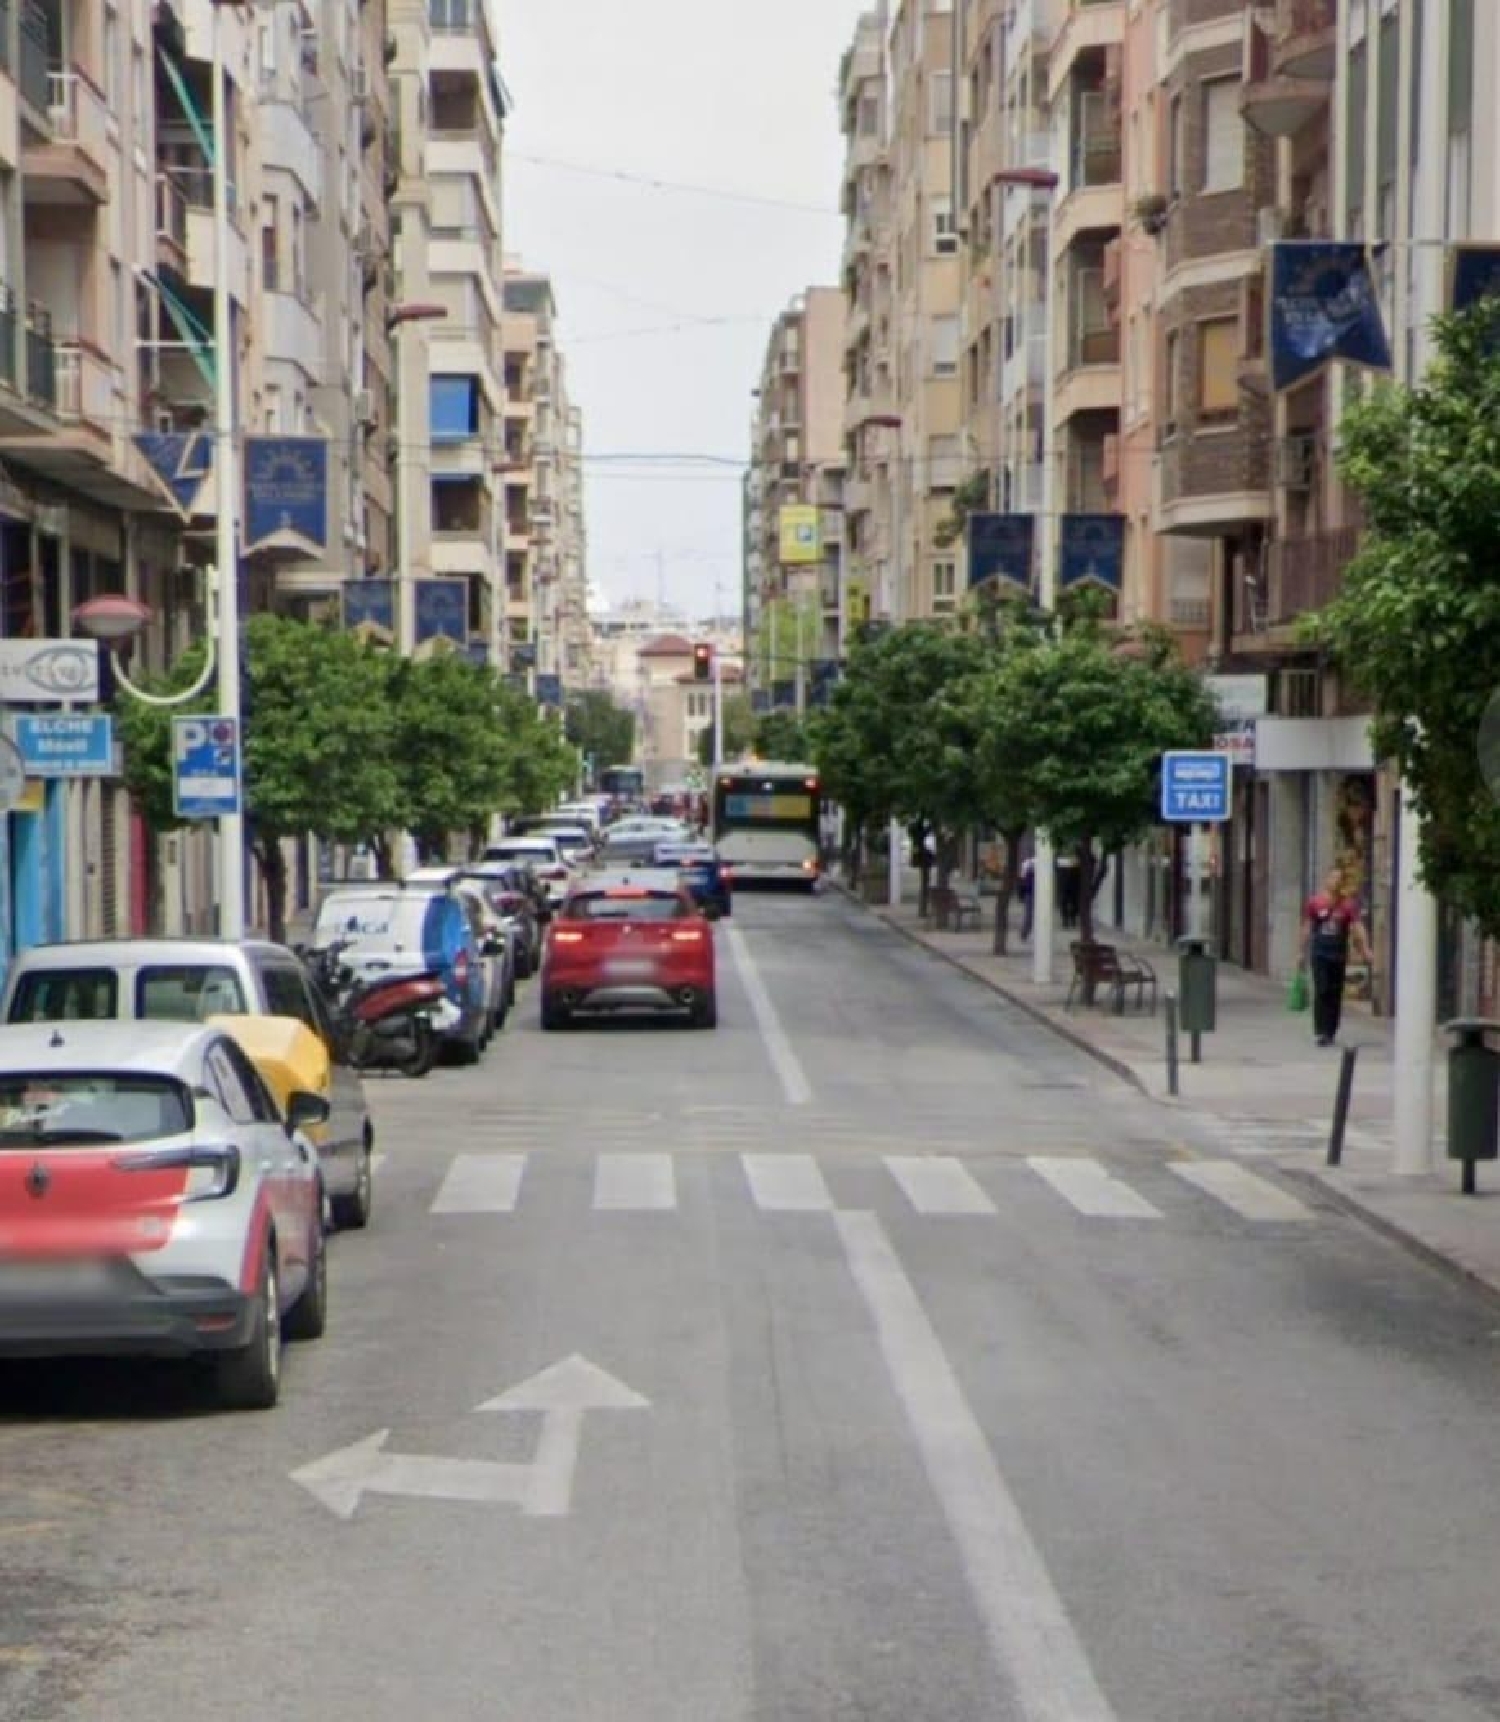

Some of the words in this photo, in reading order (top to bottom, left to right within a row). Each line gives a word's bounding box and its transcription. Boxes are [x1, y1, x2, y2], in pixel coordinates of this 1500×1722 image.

[29, 719, 93, 734] ELCHE
[177, 723, 205, 760] P
[1175, 791, 1221, 810] TAXI
